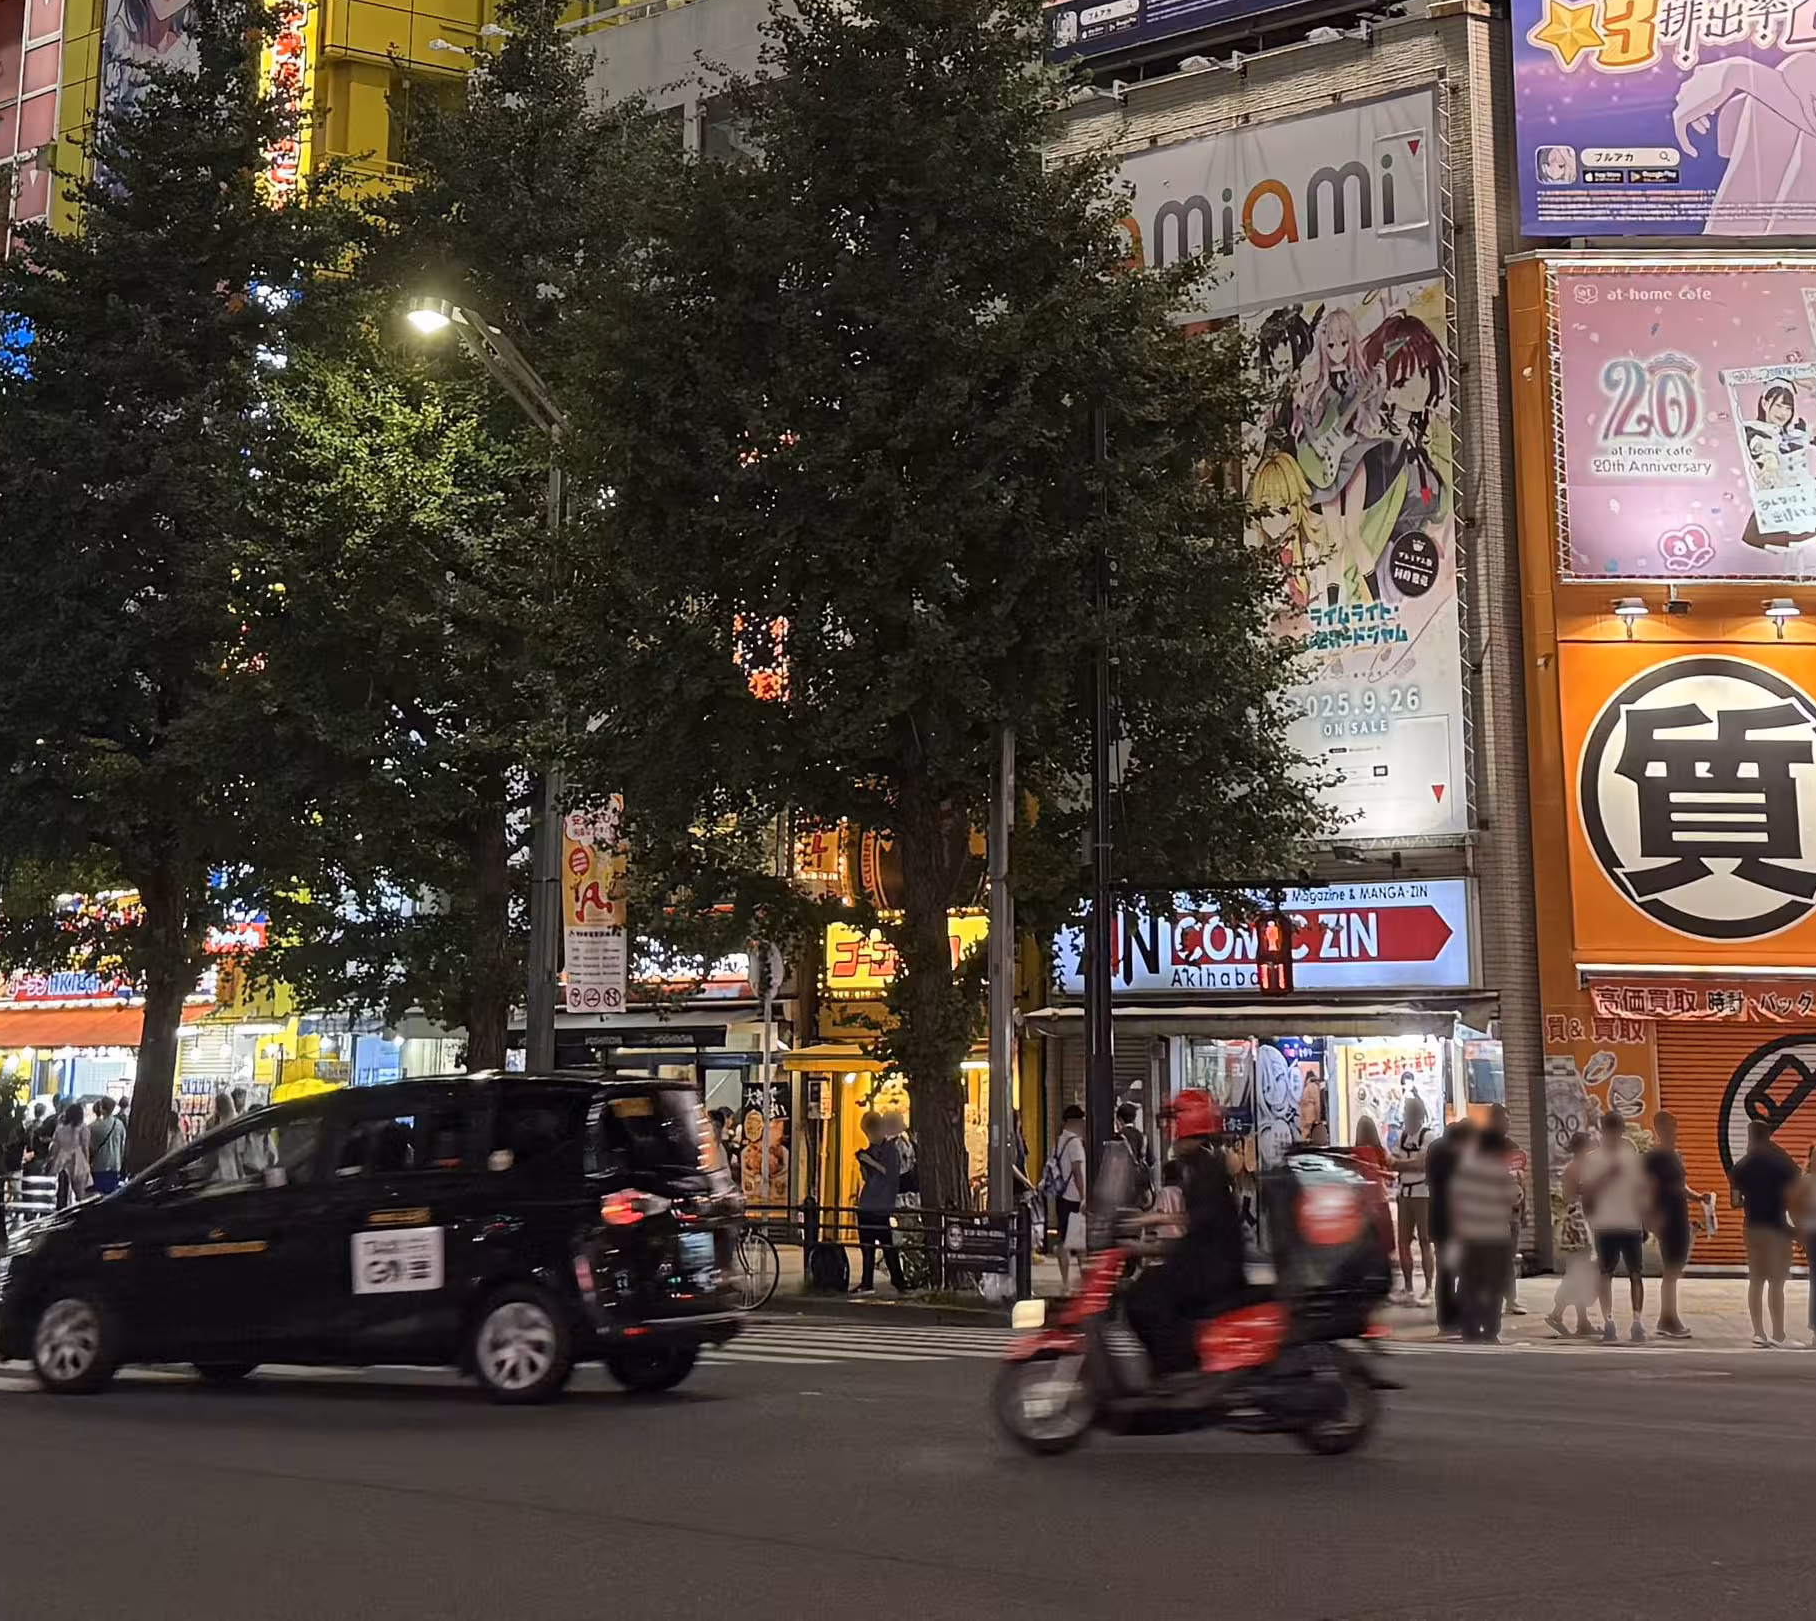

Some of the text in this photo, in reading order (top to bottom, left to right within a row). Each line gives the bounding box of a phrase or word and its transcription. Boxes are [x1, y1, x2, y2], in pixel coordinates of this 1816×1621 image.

[1677, 286, 1713, 301] cafe
[1602, 358, 1699, 441] 20
[1592, 458, 1713, 477] 20th Anniversary
[1322, 720, 1389, 737] ON SALE
[1318, 912, 1379, 959] ZIN
[1594, 986, 1699, 1016] 高価買取
